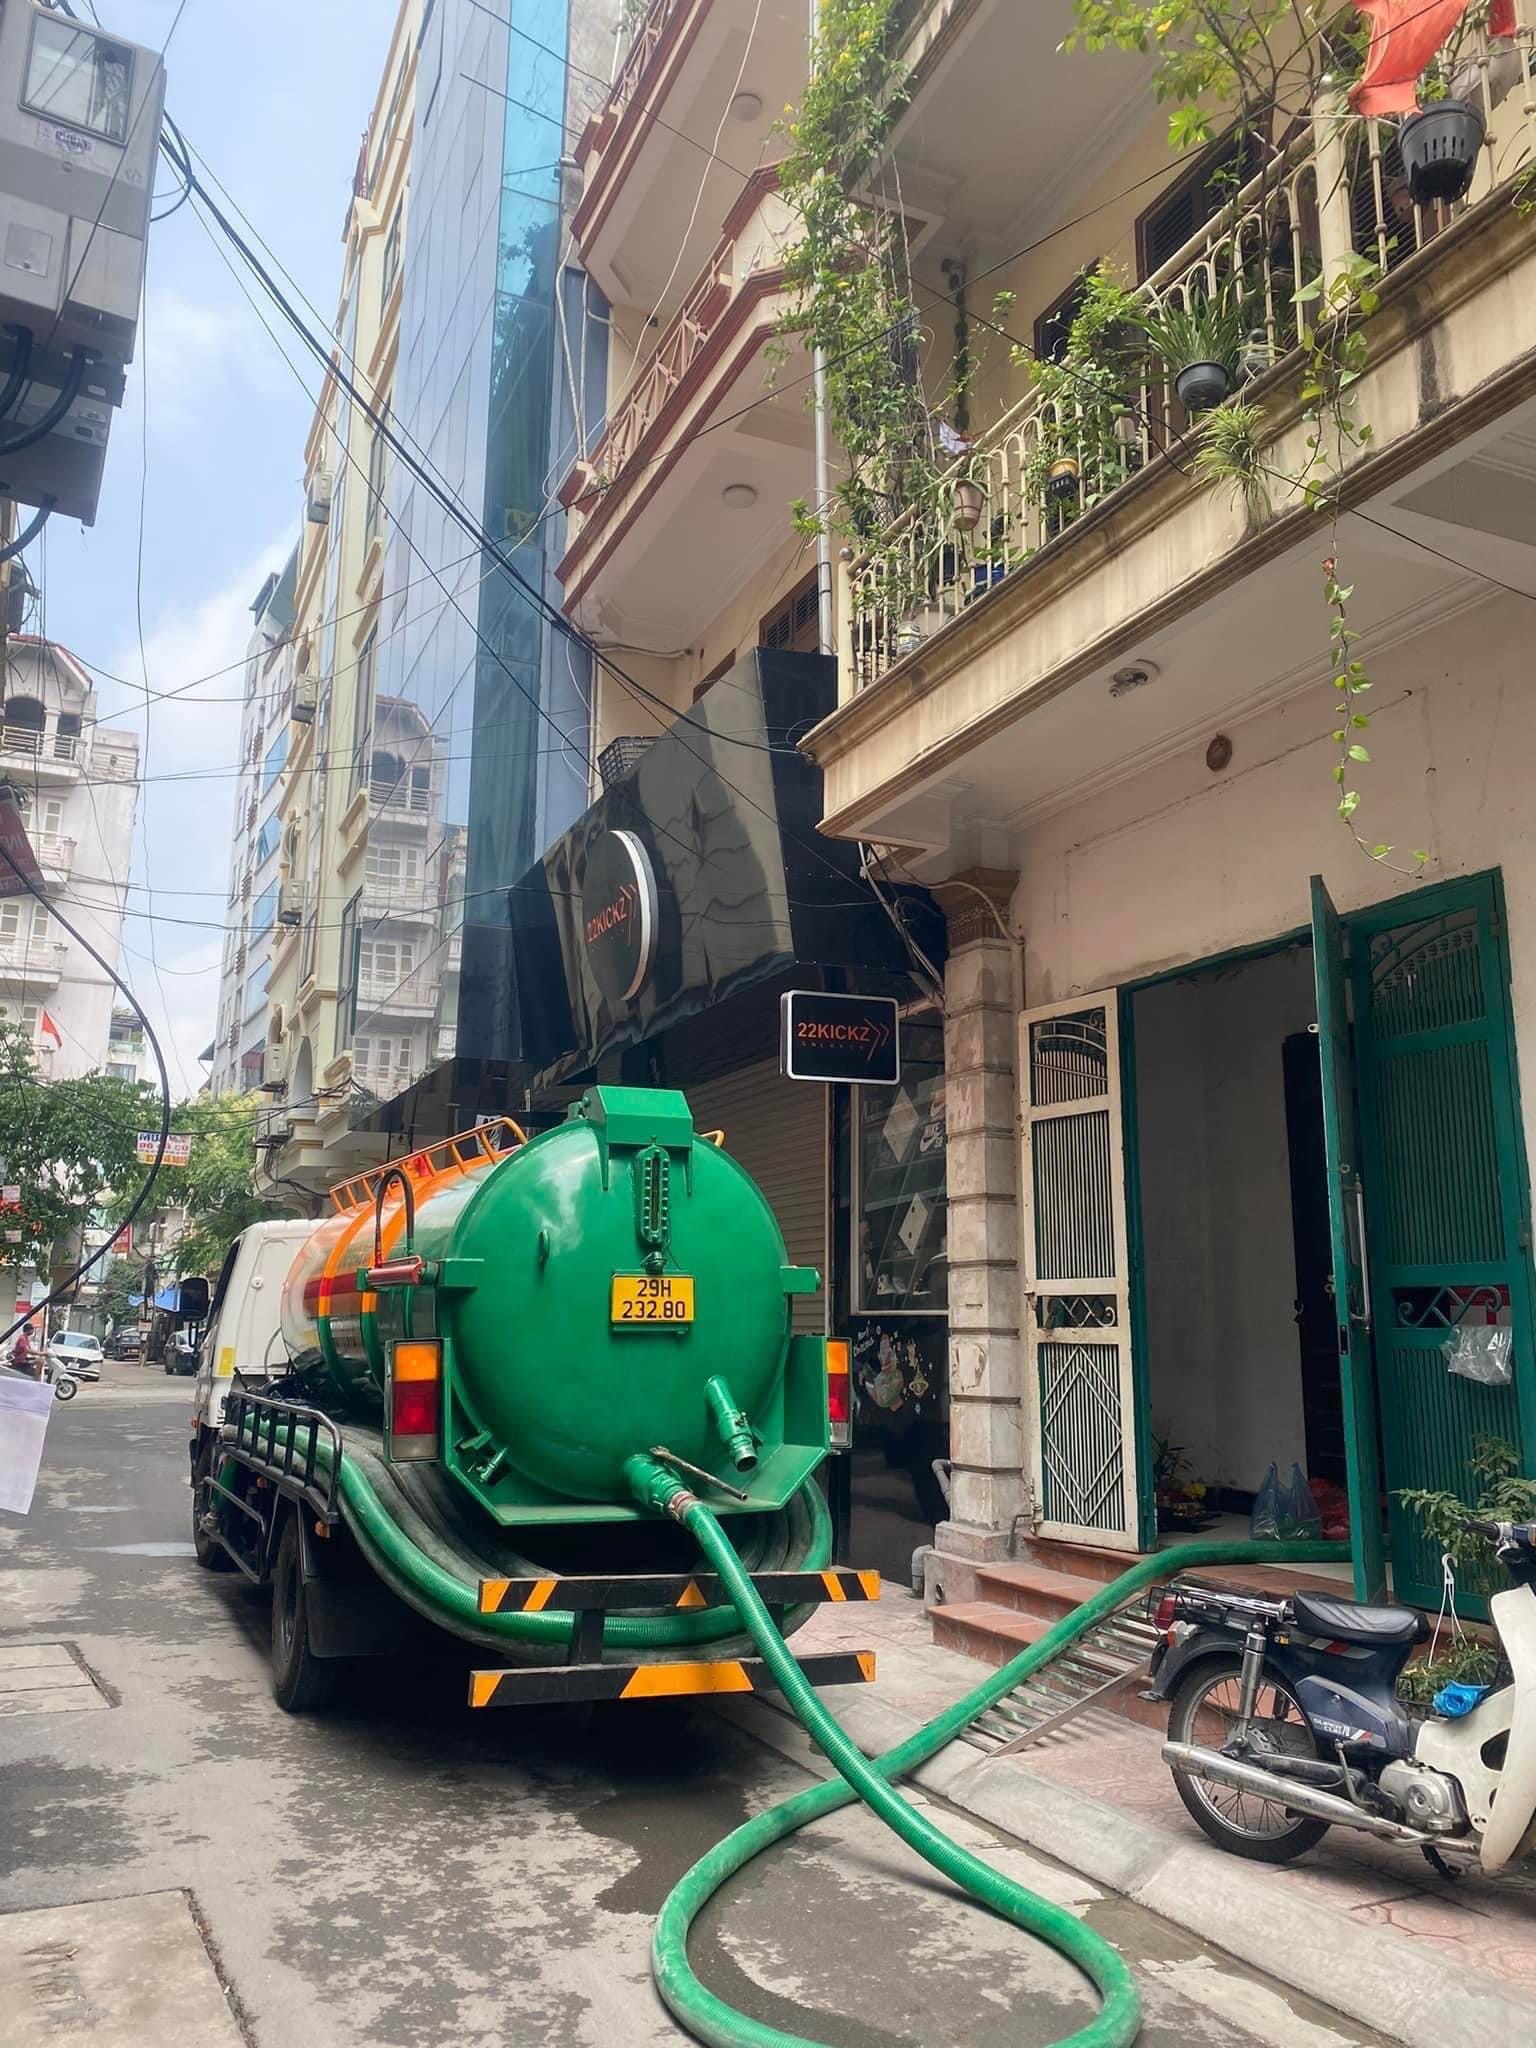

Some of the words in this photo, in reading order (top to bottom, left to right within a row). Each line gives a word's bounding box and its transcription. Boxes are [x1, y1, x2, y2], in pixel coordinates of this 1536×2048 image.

[586, 896, 627, 943] 22KICKZ
[798, 1022, 871, 1042] 22KICKZ
[637, 1279, 672, 1297] 29H
[622, 1300, 686, 1319] 232.80
